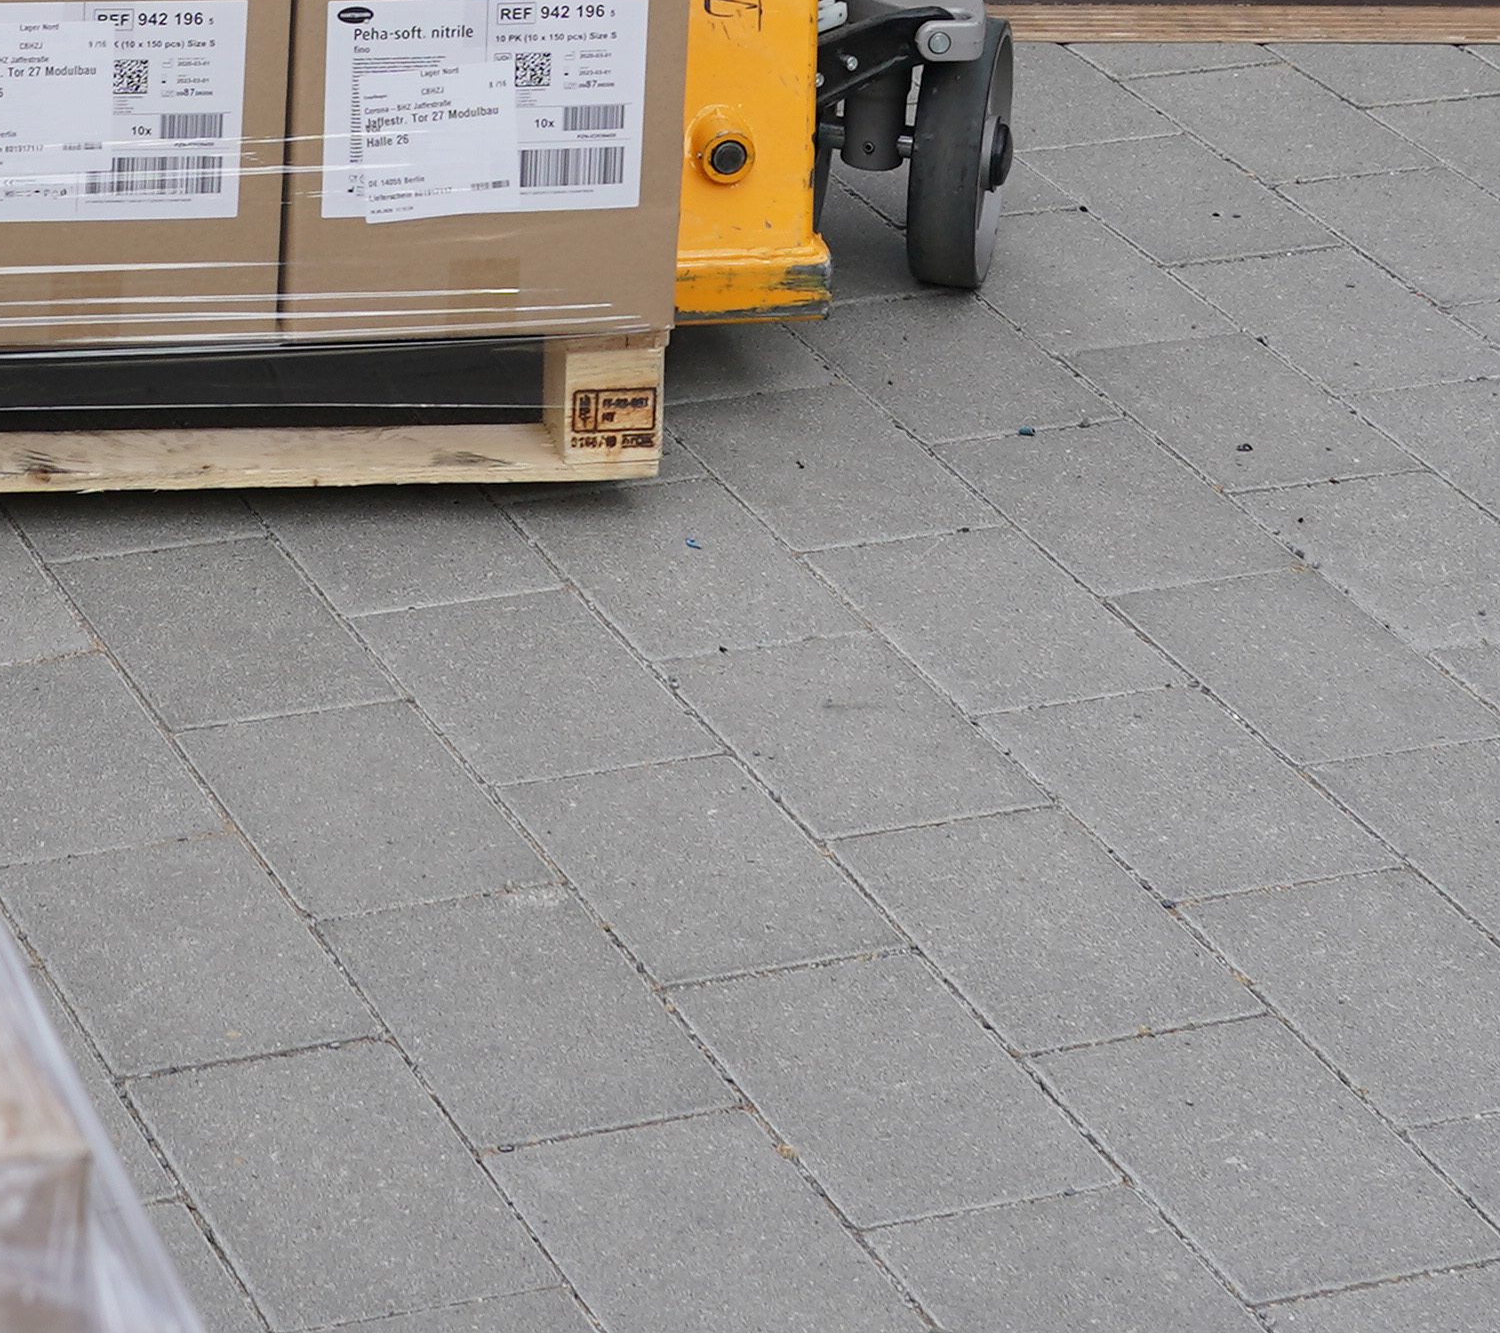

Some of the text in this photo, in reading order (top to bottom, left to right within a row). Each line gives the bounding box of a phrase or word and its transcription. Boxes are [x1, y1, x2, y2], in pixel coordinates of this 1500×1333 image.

[137, 11, 169, 27] 942
[173, 11, 205, 27] 196
[500, 7, 533, 21] REF
[540, 5, 571, 20] 942
[575, 4, 606, 19] 196
[19, 23, 60, 33] Lager Nord
[430, 24, 475, 39] nitrile
[495, 34, 507, 43] 10
[508, 34, 523, 43] PK
[524, 33, 539, 44] (10
[549, 33, 565, 42] 150
[566, 32, 588, 44] pcs)
[588, 32, 609, 41] Size
[610, 31, 618, 40] S
[121, 39, 136, 50] (10
[146, 39, 163, 49] 150
[164, 39, 186, 51] pcs)
[186, 39, 207, 49] Size
[208, 38, 217, 48] S
[353, 45, 371, 54] fino
[8, 66, 25, 78] Tor
[27, 66, 42, 77] 27
[44, 64, 98, 77] Modulbau
[420, 69, 440, 78] Lager
[411, 112, 429, 124] Tor
[432, 110, 445, 122] 27
[448, 107, 499, 120] Modulbau
[534, 118, 555, 129] 10x
[131, 125, 153, 137] 10x
[366, 135, 394, 149] Halle
[404, 175, 425, 185] Berlin
